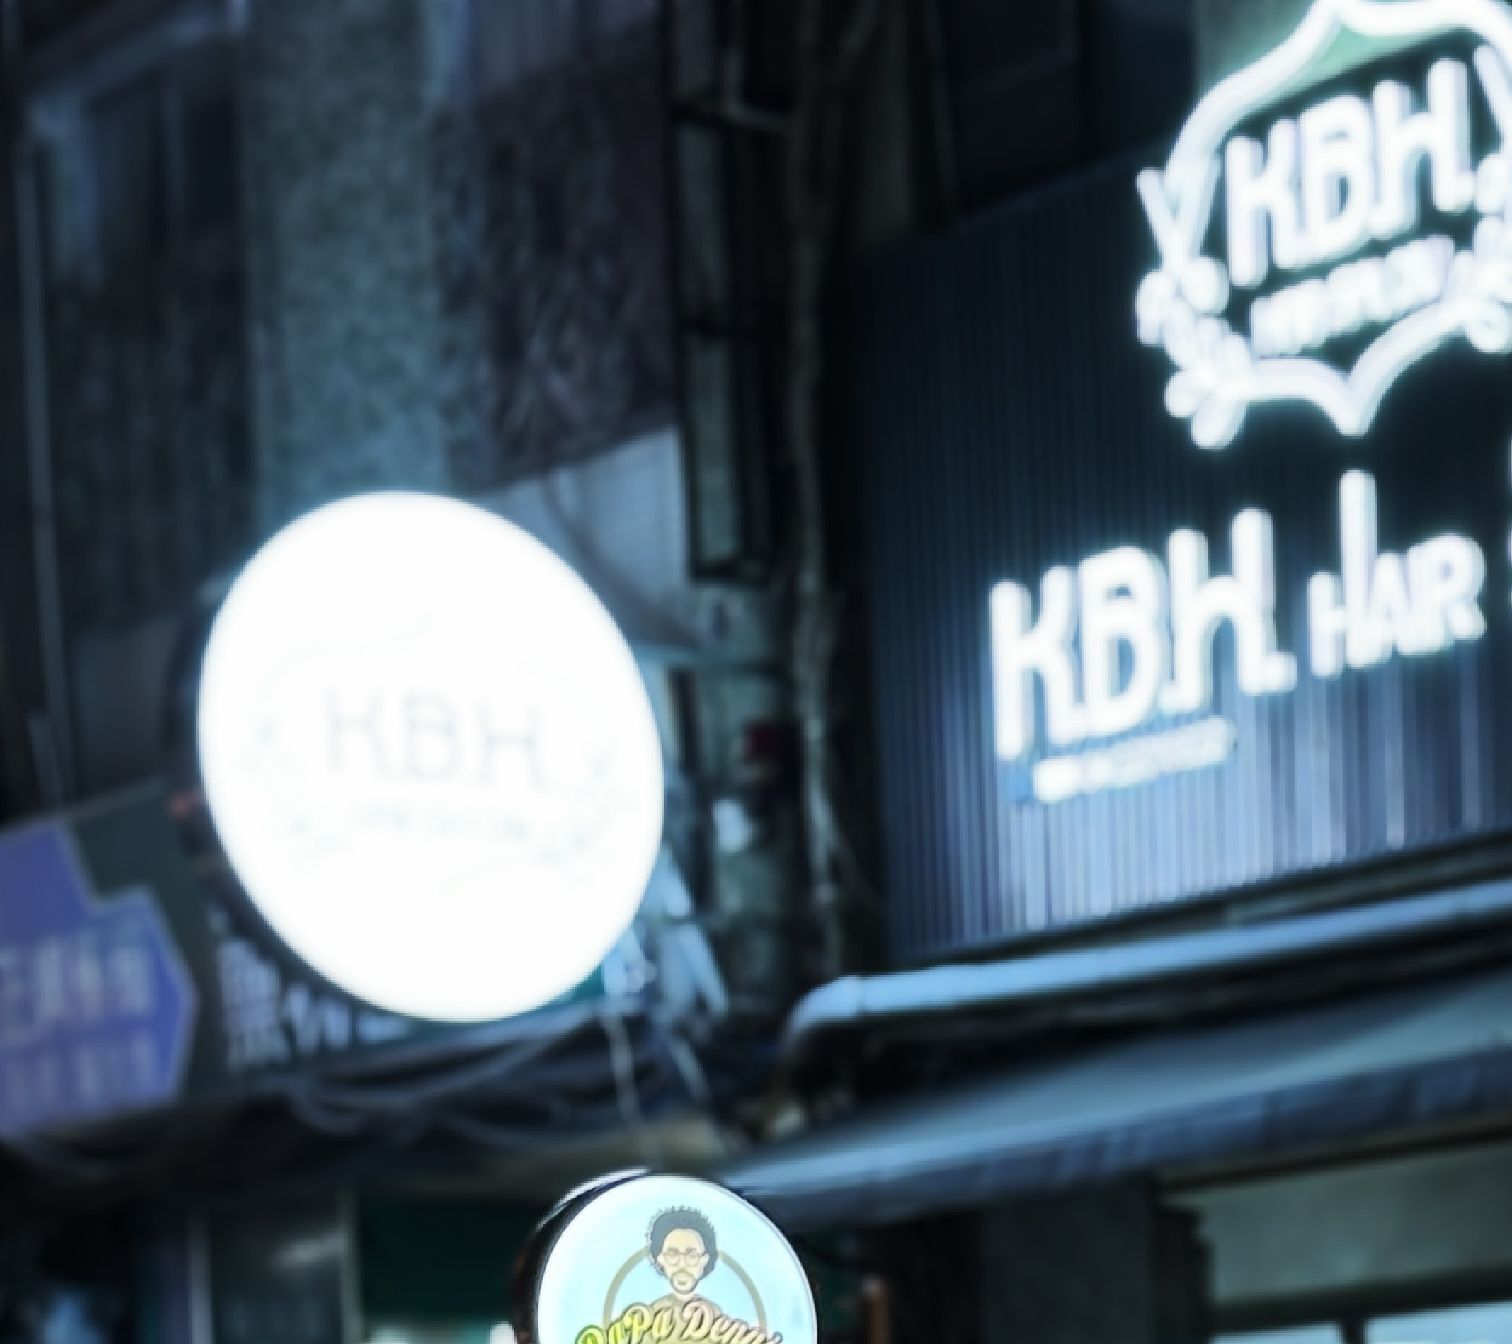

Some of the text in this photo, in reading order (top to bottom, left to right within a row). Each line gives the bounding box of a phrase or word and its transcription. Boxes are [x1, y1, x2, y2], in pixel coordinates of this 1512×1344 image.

[1227, 58, 1475, 287] KBH
[991, 509, 1296, 758] KBH
[1309, 470, 1484, 676] HAIR
[320, 682, 551, 793] KBH
